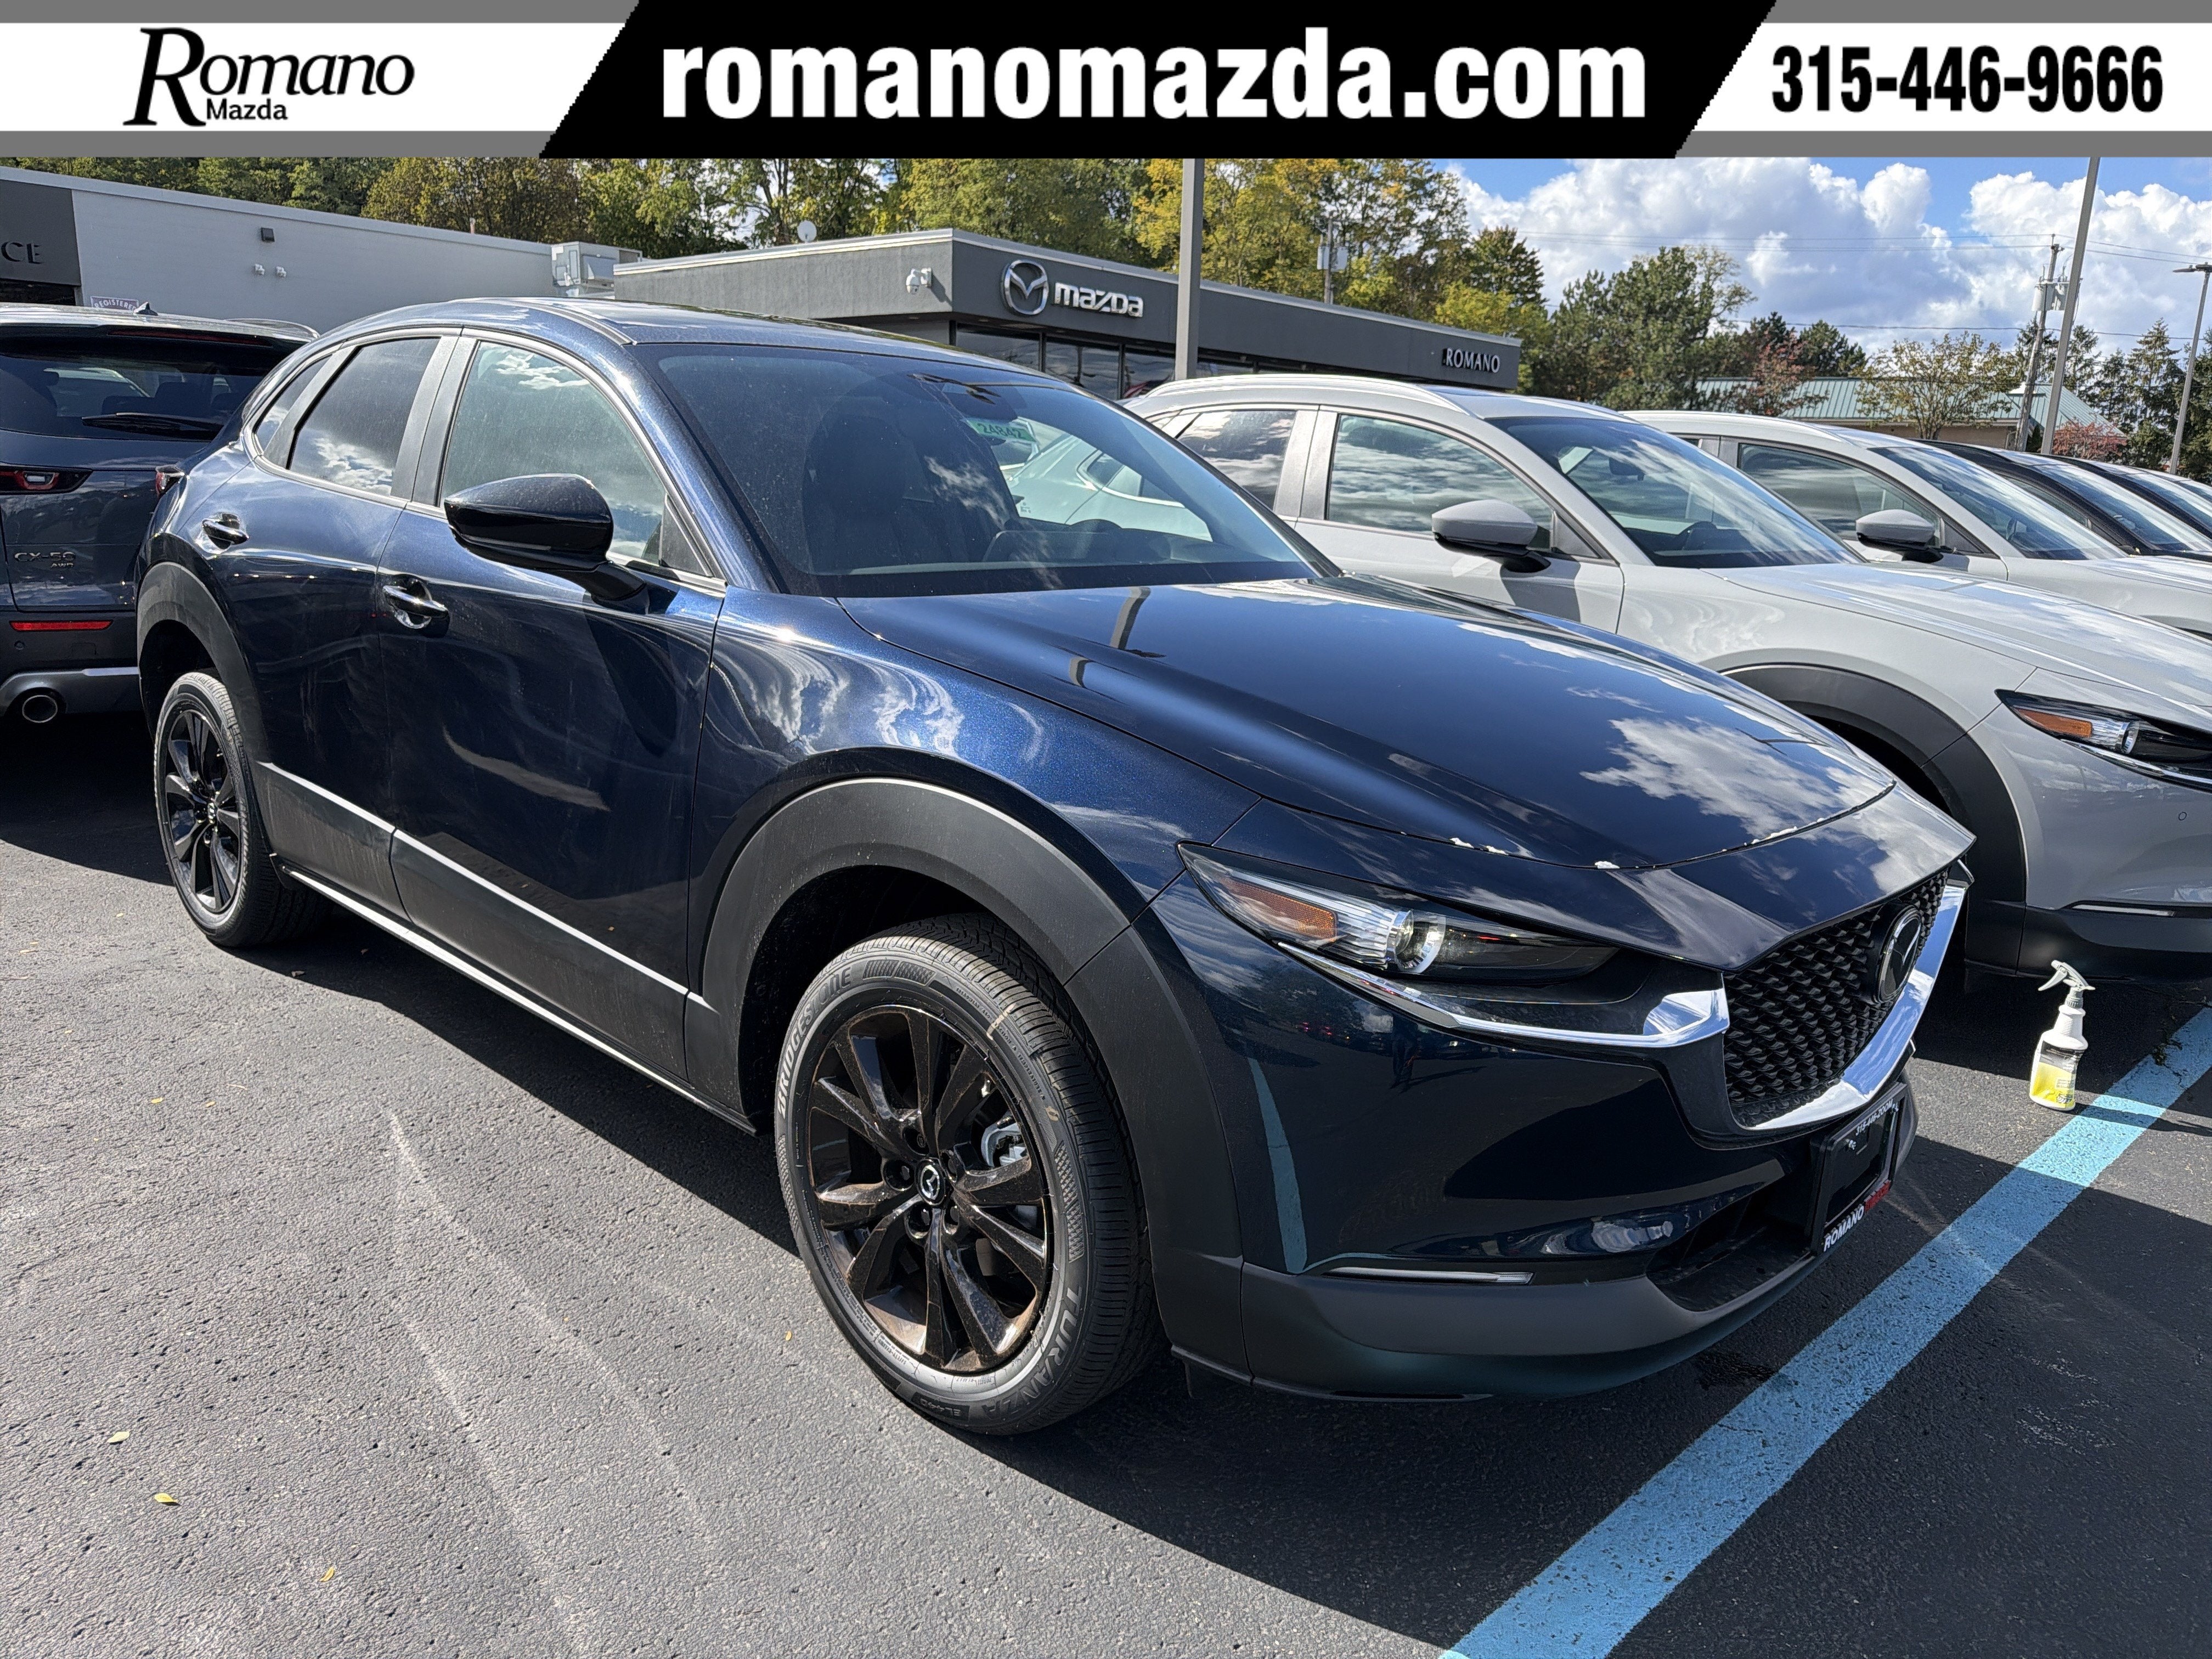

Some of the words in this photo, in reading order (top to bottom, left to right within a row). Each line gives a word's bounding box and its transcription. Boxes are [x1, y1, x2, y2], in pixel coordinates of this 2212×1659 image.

[1054, 282, 1144, 318] mazda
[1446, 347, 1500, 373] ROMANO
[14, 551, 76, 561] CX-50
[777, 968, 852, 1120] BRIDGESTONE
[1824, 1205, 1864, 1252] ROMANO
[981, 1285, 1082, 1420] TURANZA
